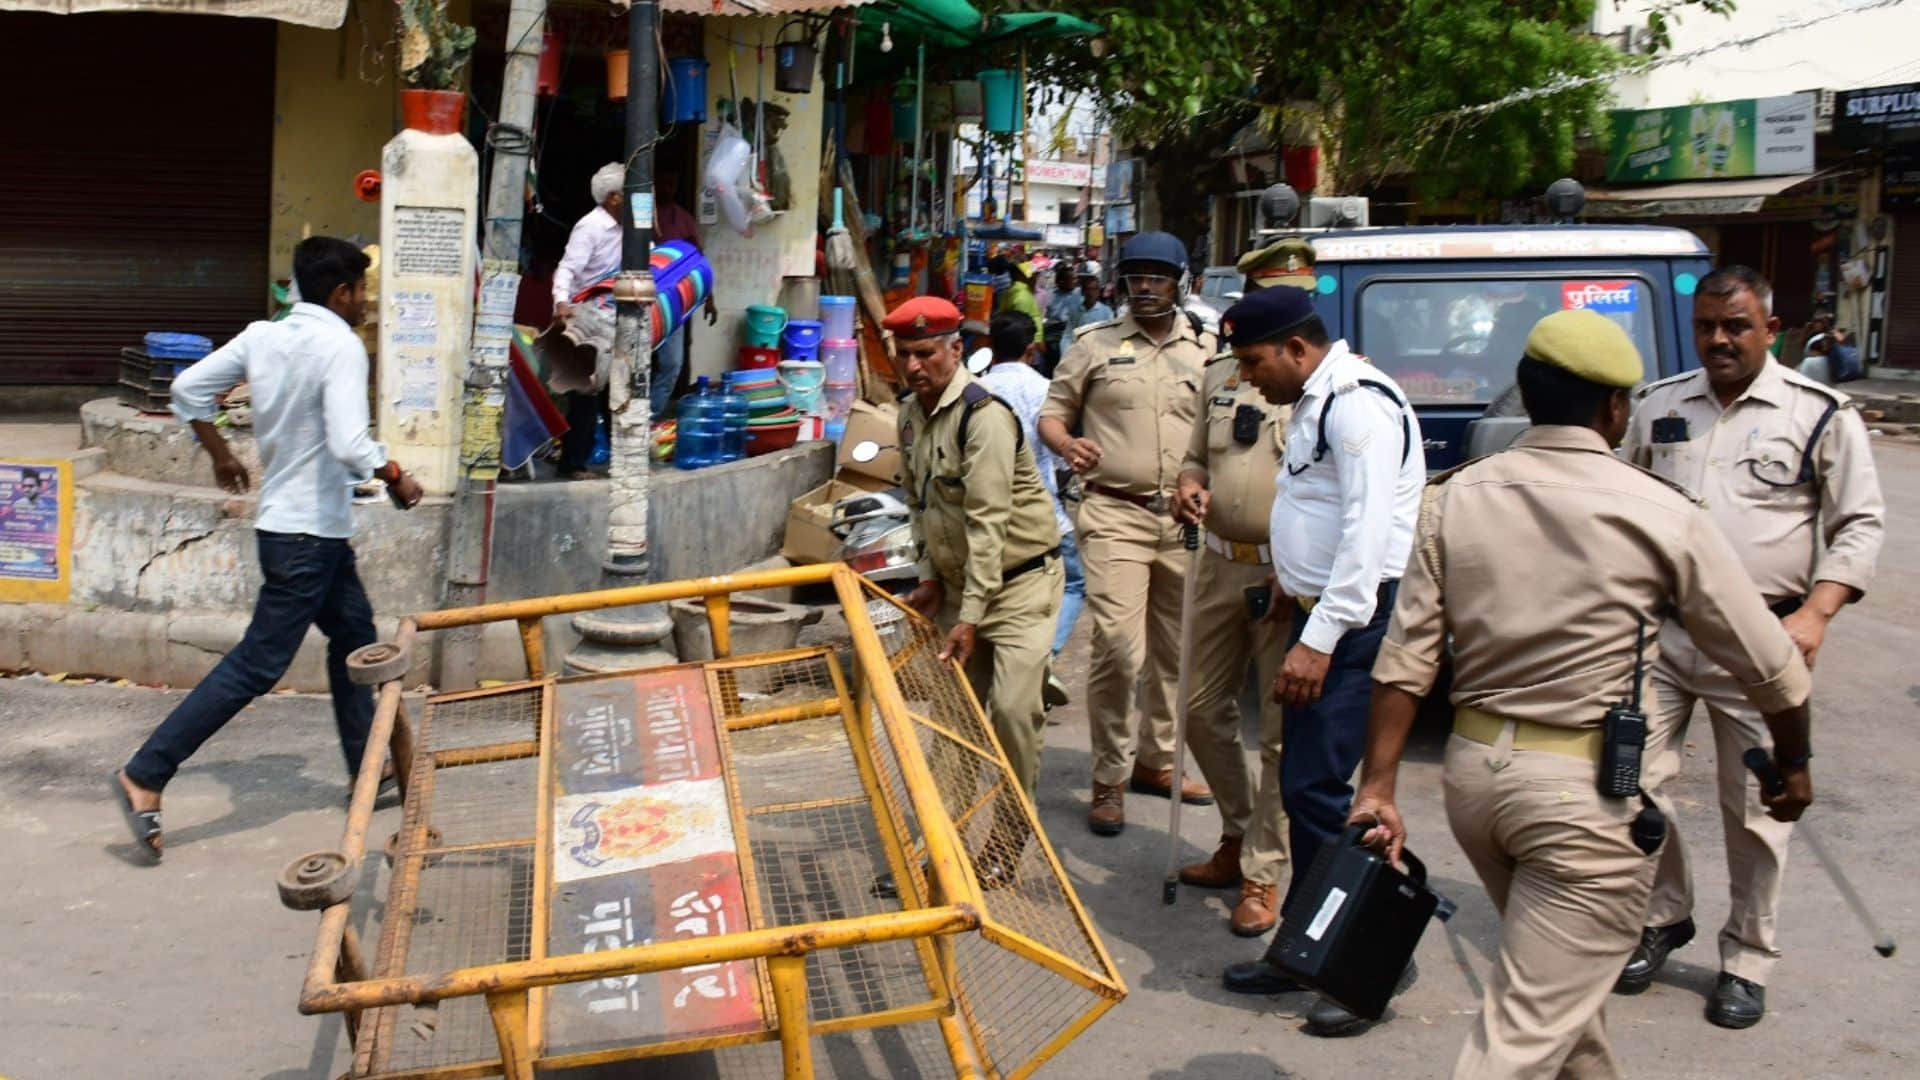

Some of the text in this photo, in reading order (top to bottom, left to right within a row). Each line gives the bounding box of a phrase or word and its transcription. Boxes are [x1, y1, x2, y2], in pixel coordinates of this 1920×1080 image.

[1027, 165, 1088, 180] MOMENTUM
[1565, 283, 1633, 309] पुलिस
[567, 703, 633, 776] पुलिस
[646, 684, 700, 781] यातायात
